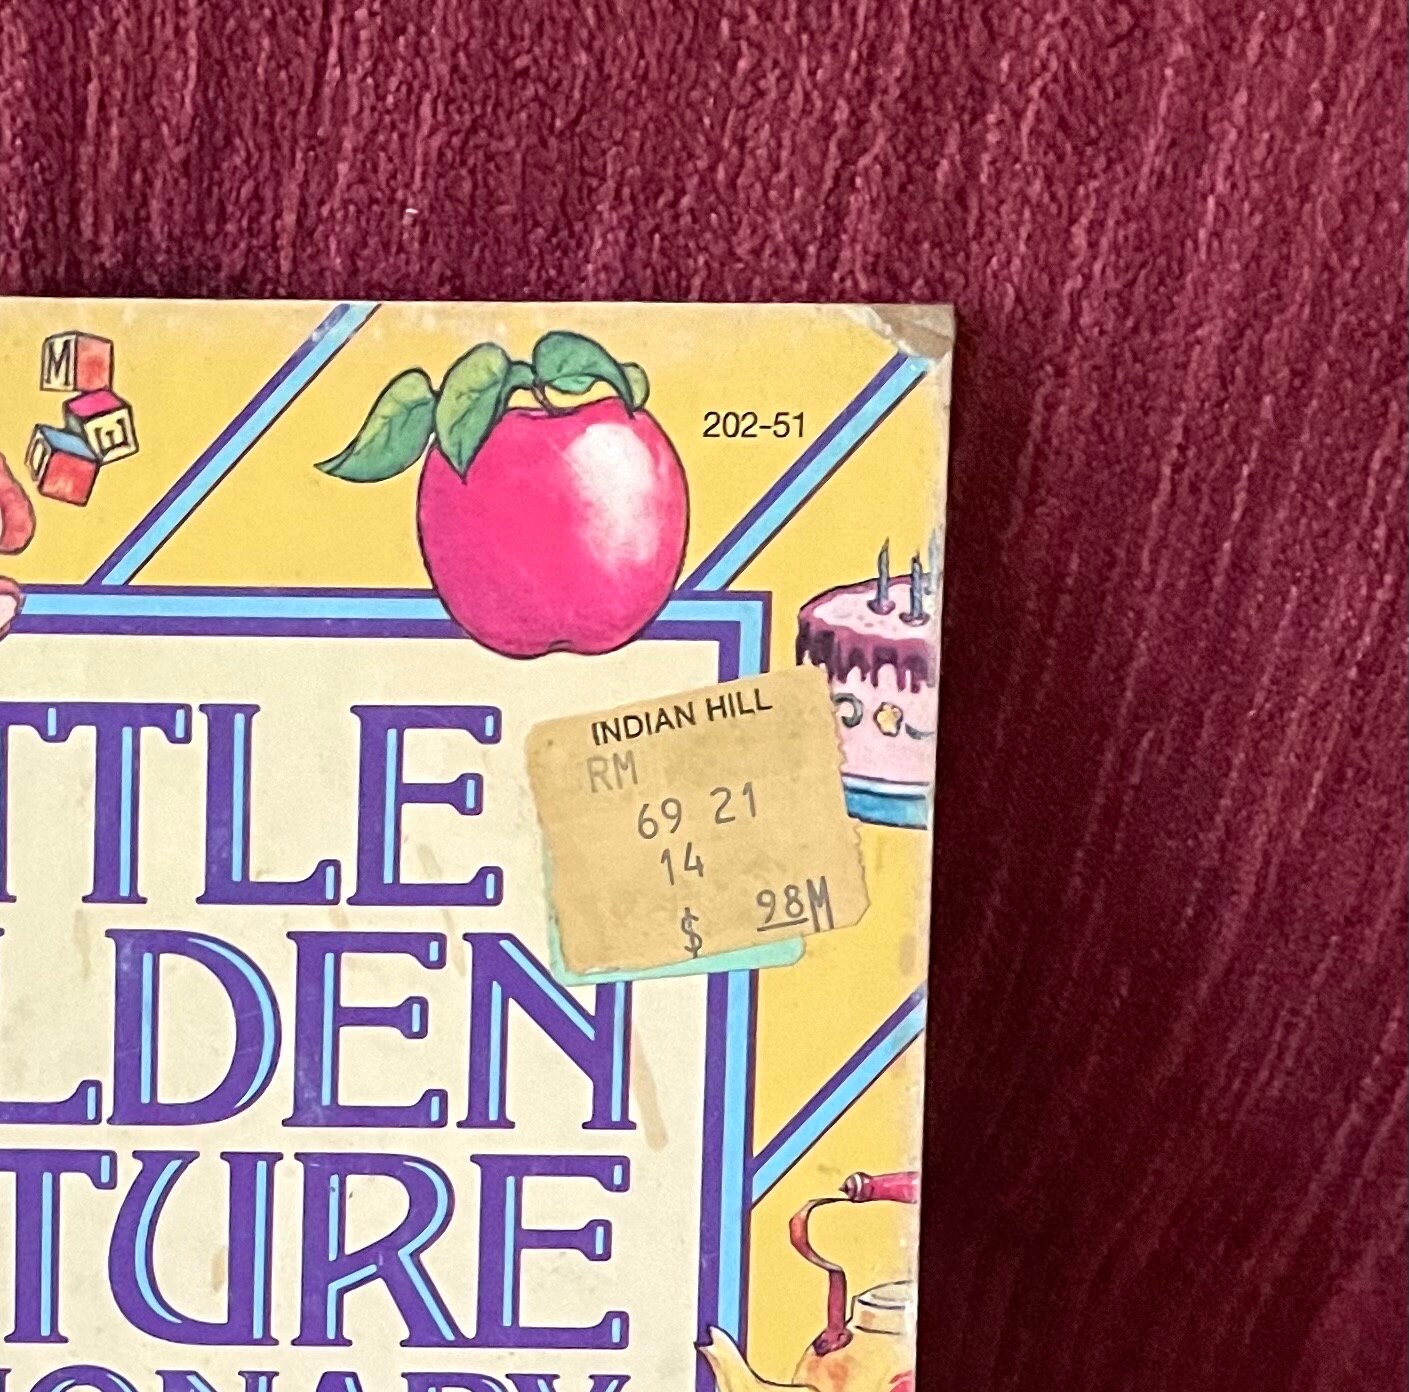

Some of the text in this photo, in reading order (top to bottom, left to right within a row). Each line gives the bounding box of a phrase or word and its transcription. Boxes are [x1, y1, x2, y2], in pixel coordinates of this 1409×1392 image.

[702, 411, 804, 438] 202-51
[591, 688, 773, 746] INDIAN HILL
[586, 750, 639, 793] RM
[637, 781, 757, 840] 69 21
[660, 841, 704, 886] 14
